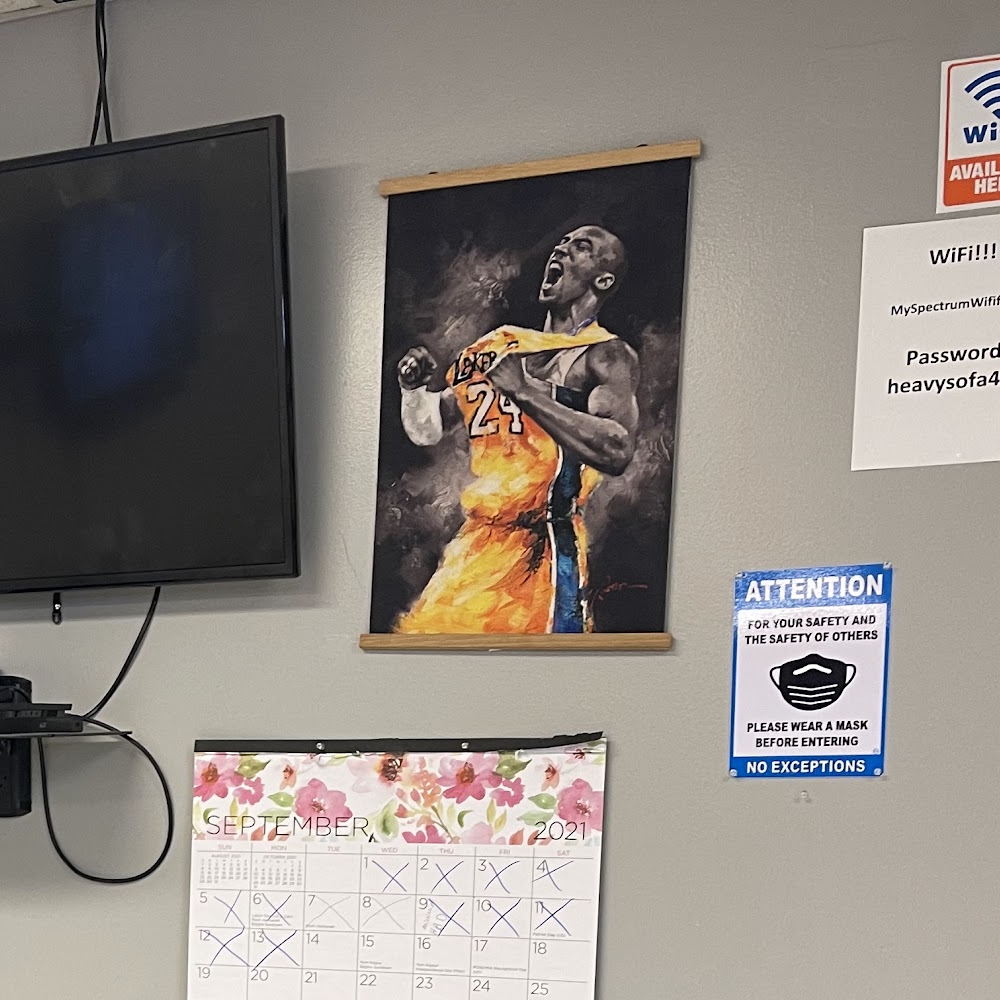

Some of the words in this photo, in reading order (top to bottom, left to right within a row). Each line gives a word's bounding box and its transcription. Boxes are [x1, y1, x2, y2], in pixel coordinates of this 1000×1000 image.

[963, 122, 1000, 144] Wi
[929, 243, 997, 265] WiFi!!!
[906, 342, 1000, 366] Password
[452, 351, 498, 387] LAKER
[888, 370, 1000, 394] heavysofa4
[466, 380, 524, 438] 24
[745, 574, 883, 602] ATTENTION
[748, 620, 770, 630] FOR
[773, 618, 803, 629] YOUR
[805, 616, 849, 627] SAFETY
[852, 615, 876, 625] AND
[745, 635, 767, 645] THE
[769, 633, 812, 644] SAFETY
[814, 632, 829, 642] OF
[832, 630, 878, 642] OTHERS
[747, 722, 788, 733] PLEASE
[791, 721, 823, 732] WEAR
[825, 721, 833, 731] A
[836, 720, 868, 731] MASK
[756, 738, 799, 748] BEFORE
[801, 736, 859, 747] ENTERING
[746, 761, 767, 773] NO
[772, 760, 866, 773] EXCEPTIONS
[206, 815, 370, 837] SEPTEMBER
[534, 821, 586, 841] 2021
[363, 857, 369, 869] 1
[420, 858, 429, 871] 2
[477, 859, 487, 872] 3
[536, 860, 547, 873] 4
[200, 892, 208, 904] 5
[252, 893, 262, 905] 6
[307, 894, 316, 907] 7
[362, 896, 372, 908] 8
[419, 897, 428, 910] 9
[476, 899, 491, 912] 10
[199, 930, 211, 942] 12
[252, 931, 265, 943] 13
[306, 933, 319, 945] 14
[362, 935, 375, 947] 15
[417, 937, 431, 950] 16
[474, 939, 488, 952] 17
[534, 942, 547, 955] 18
[198, 966, 211, 979] 19
[250, 969, 269, 982] 20
[304, 971, 318, 984] 21
[359, 974, 377, 987] 22
[415, 976, 434, 990] 23
[472, 979, 491, 993] 24
[530, 982, 549, 996] 25
